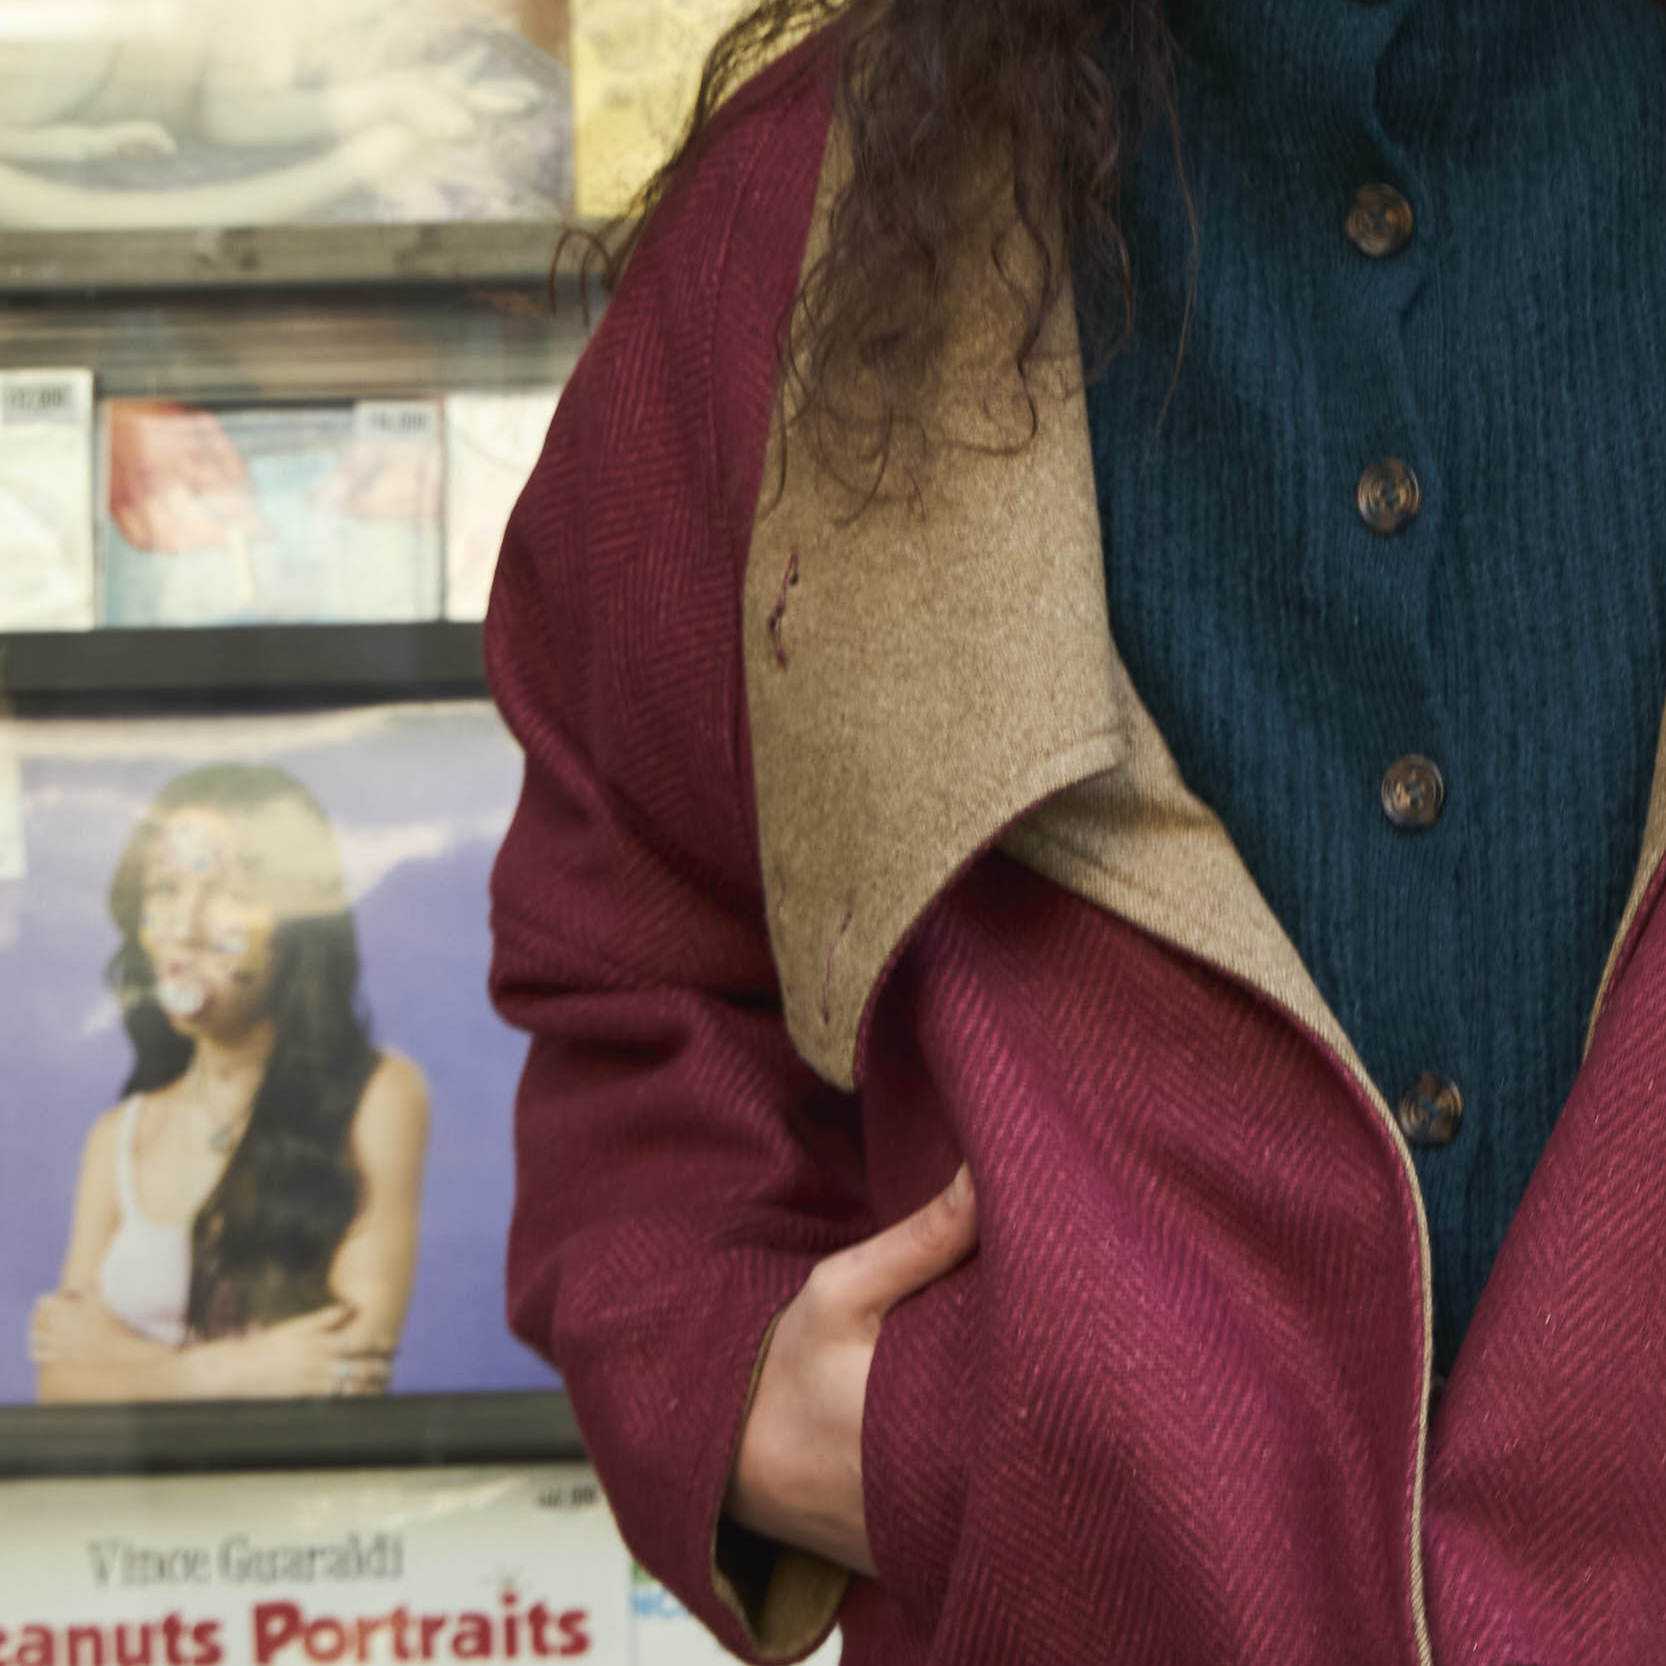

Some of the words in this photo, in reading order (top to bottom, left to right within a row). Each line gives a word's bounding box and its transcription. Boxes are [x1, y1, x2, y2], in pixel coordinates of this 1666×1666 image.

[87, 1536, 211, 1588] Vince
[217, 1531, 404, 1586] Guaraldi
[253, 1591, 592, 1666] Portraits
